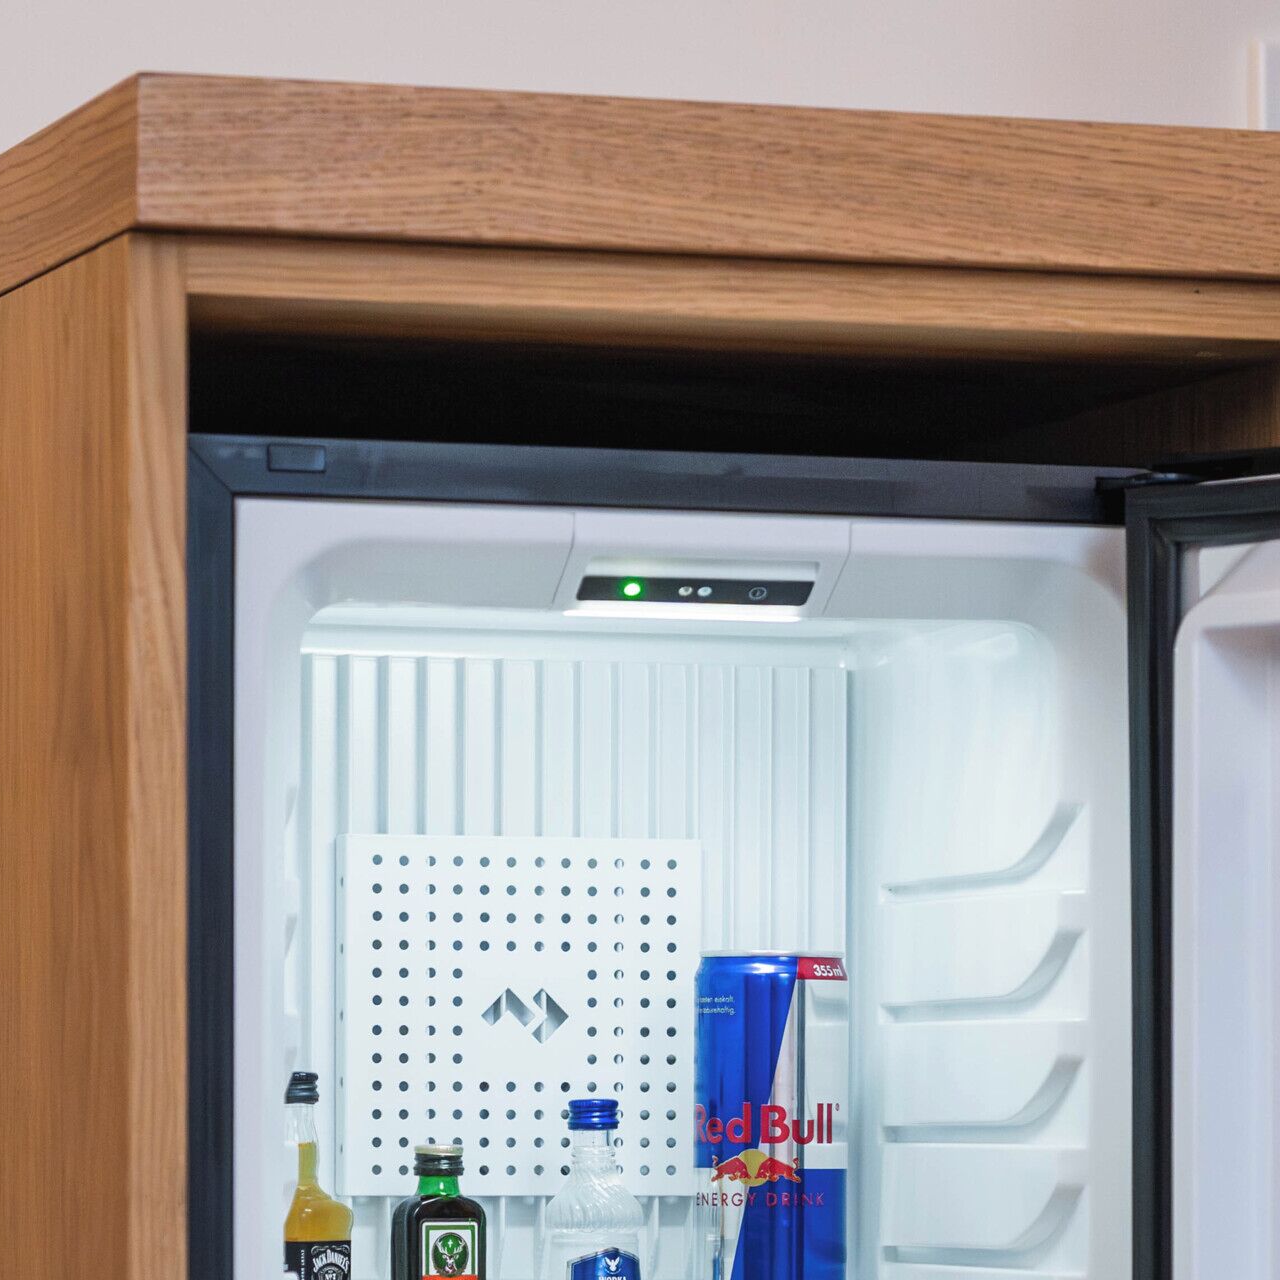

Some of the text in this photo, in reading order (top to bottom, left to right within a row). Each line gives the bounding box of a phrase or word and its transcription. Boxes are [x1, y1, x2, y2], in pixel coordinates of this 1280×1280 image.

[695, 1102, 752, 1144] Red
[696, 1192, 825, 1207] ENERGY DRINK
